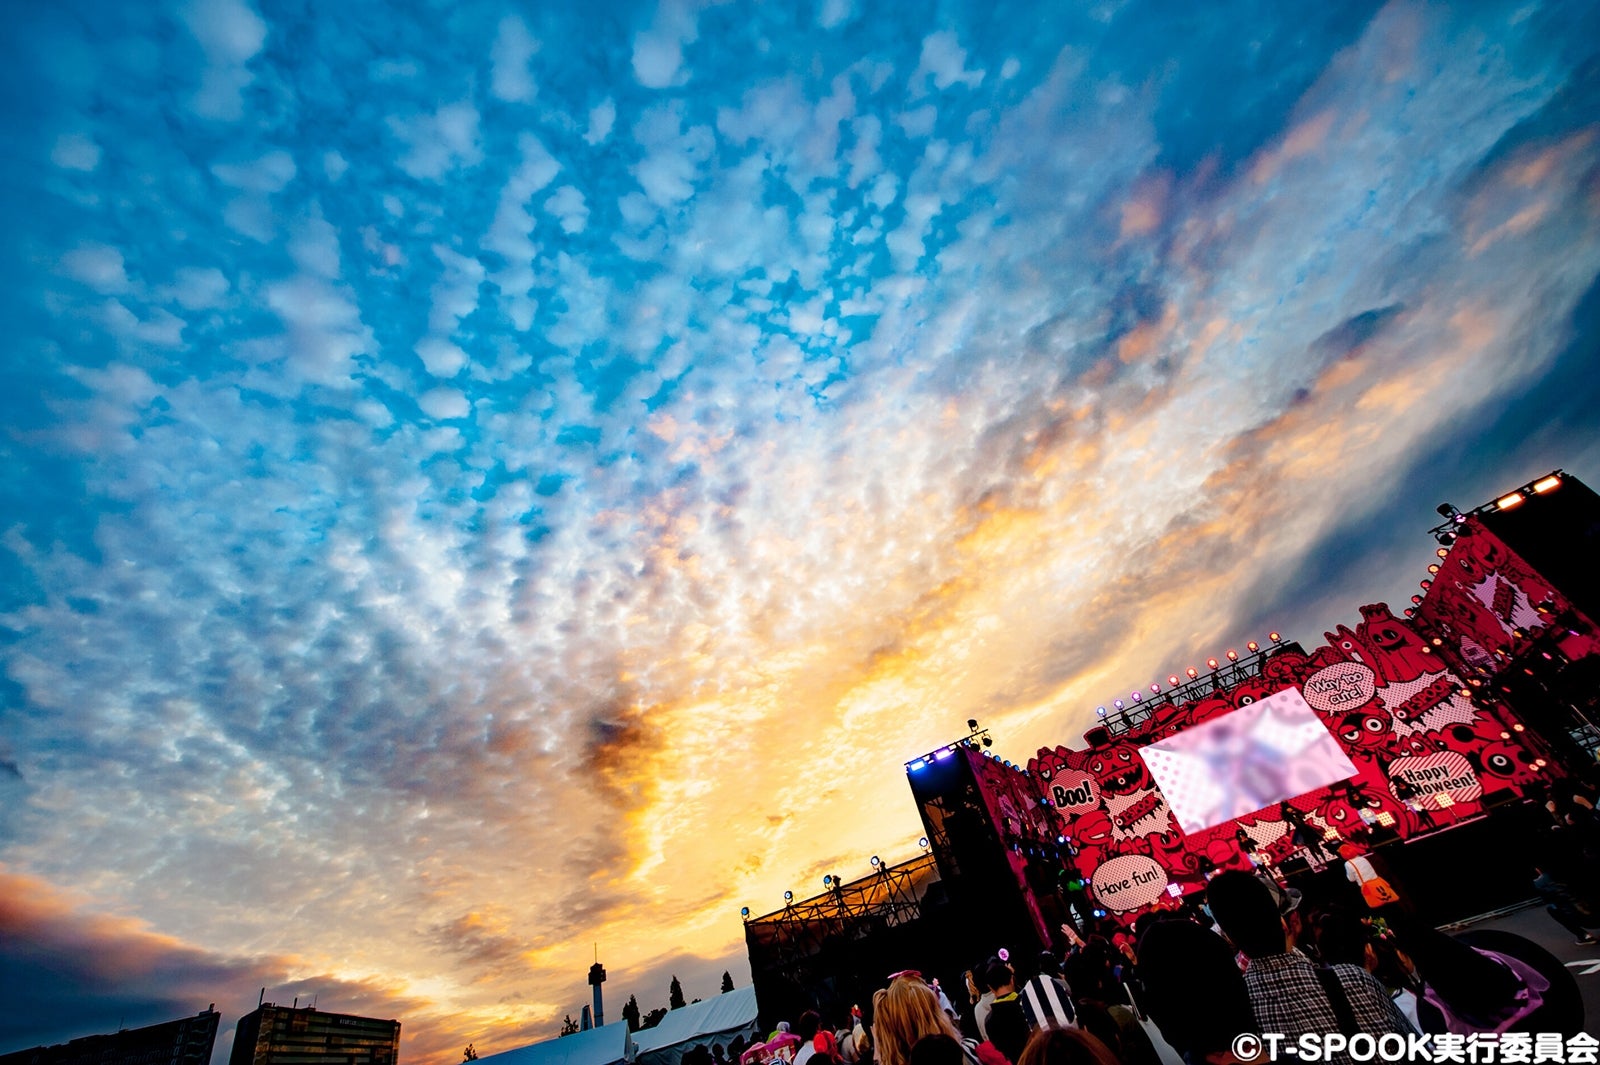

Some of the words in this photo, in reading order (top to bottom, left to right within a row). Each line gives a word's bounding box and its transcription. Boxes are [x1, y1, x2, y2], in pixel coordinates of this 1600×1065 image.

[1310, 678, 1341, 694] Way
[1341, 672, 1364, 685] too
[1329, 685, 1364, 705] cute!
[1401, 676, 1453, 712] T-SPOOK
[1403, 765, 1450, 783] Happy
[1052, 781, 1094, 808] Boo!
[1122, 793, 1158, 823] T-SPOOK
[1096, 880, 1131, 898] Have
[1131, 866, 1159, 887] fun!
